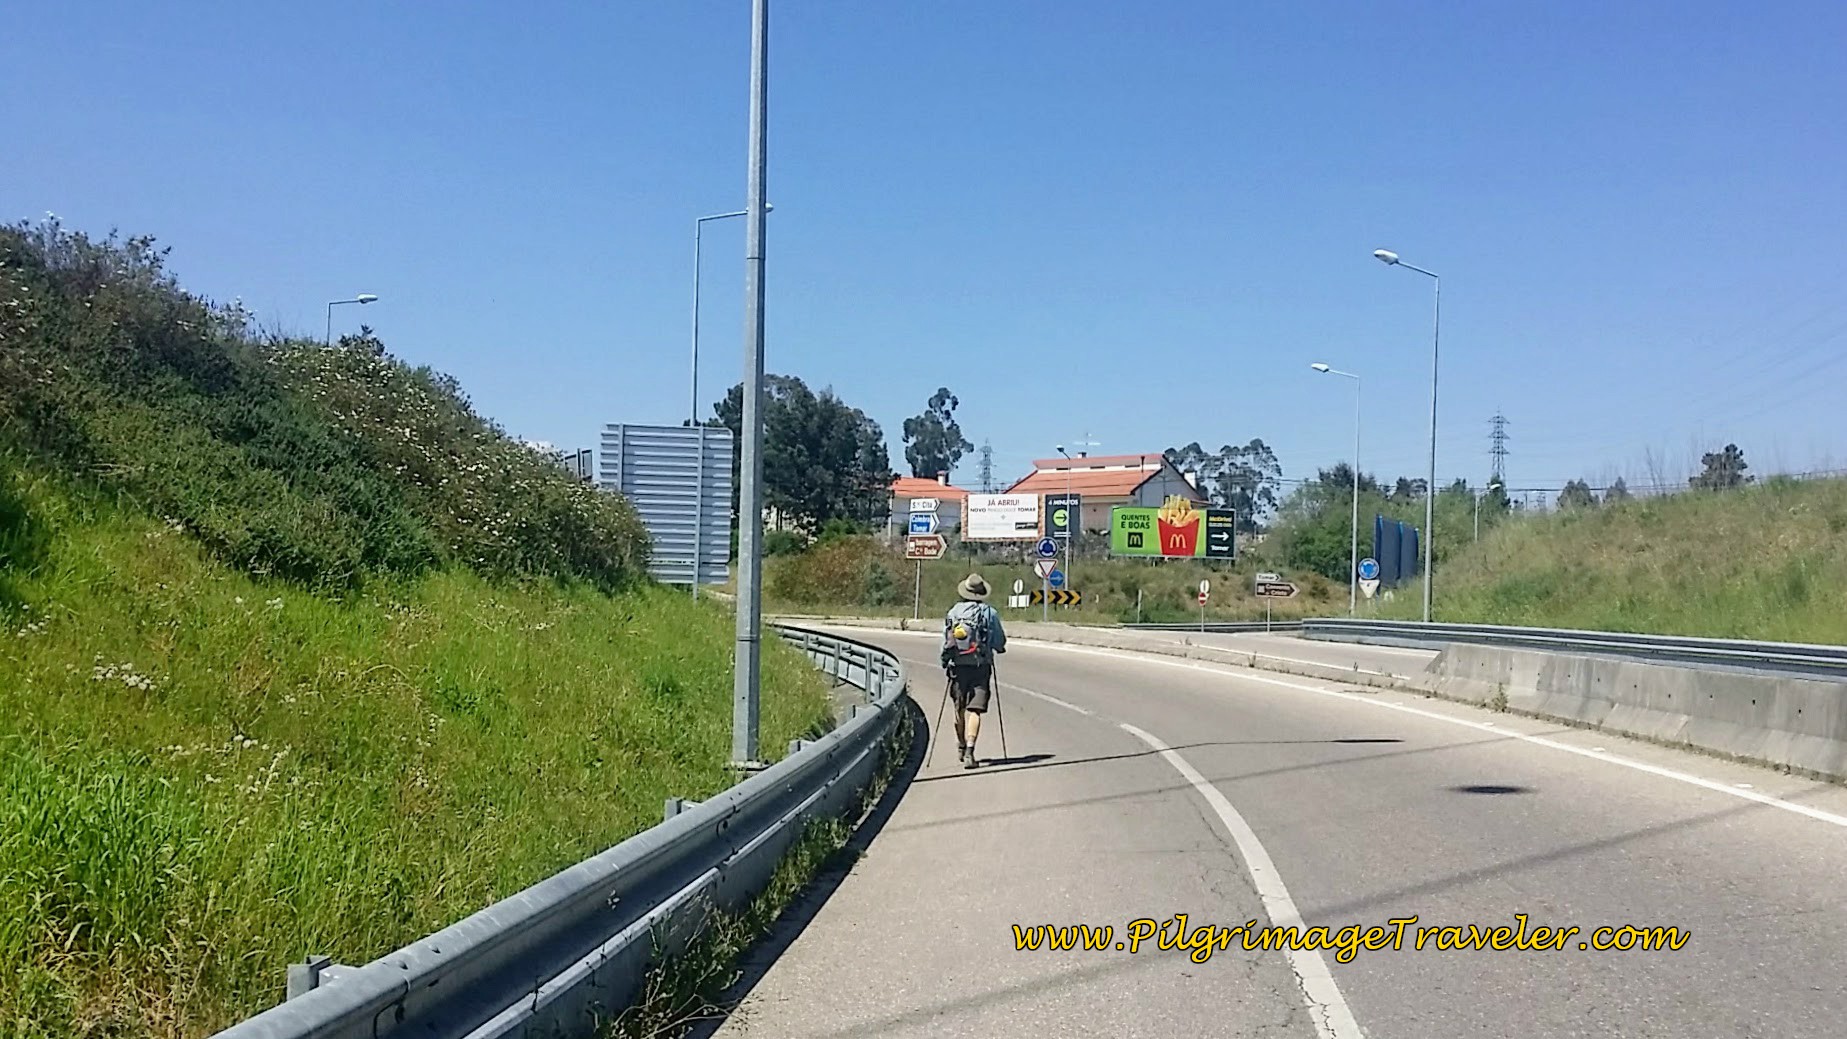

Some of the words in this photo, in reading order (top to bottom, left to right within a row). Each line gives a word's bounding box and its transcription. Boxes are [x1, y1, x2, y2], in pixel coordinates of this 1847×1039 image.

[911, 514, 930, 523] Coimbra
[1121, 514, 1150, 522] QUENTES
[913, 523, 928, 532] Tomar
[1121, 521, 1126, 529] E
[1128, 521, 1150, 529] BOAS
